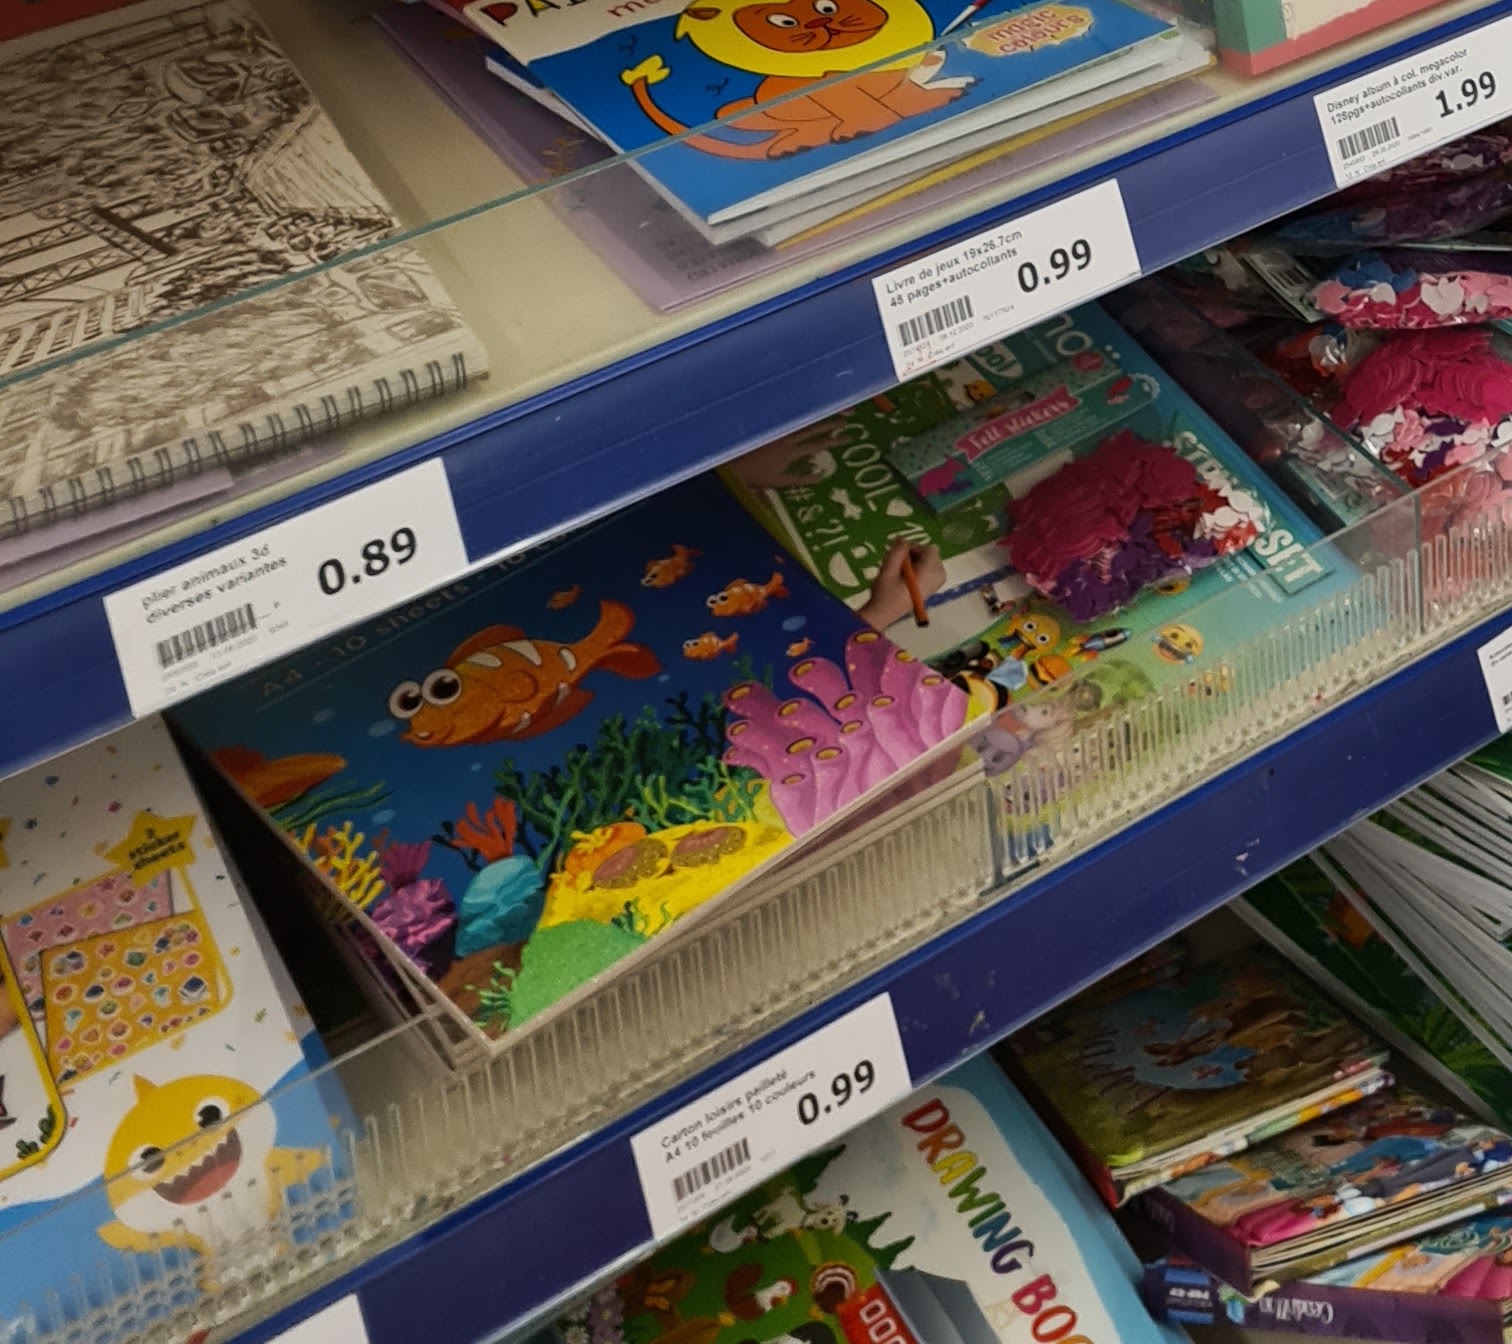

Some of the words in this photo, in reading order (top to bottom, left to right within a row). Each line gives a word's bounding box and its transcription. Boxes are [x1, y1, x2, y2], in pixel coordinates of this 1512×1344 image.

[985, 5, 1054, 43] magic
[999, 9, 1086, 57] colours
[1434, 69, 1496, 118] 1.99
[886, 277, 913, 296] Livre
[915, 268, 932, 282] de
[933, 255, 960, 281] jeux
[1016, 238, 1091, 291] 0.99
[216, 557, 287, 593] variantes
[318, 527, 417, 596] 0.89
[798, 1059, 878, 1128] 0.99
[902, 1099, 1033, 1276] DRAWING
